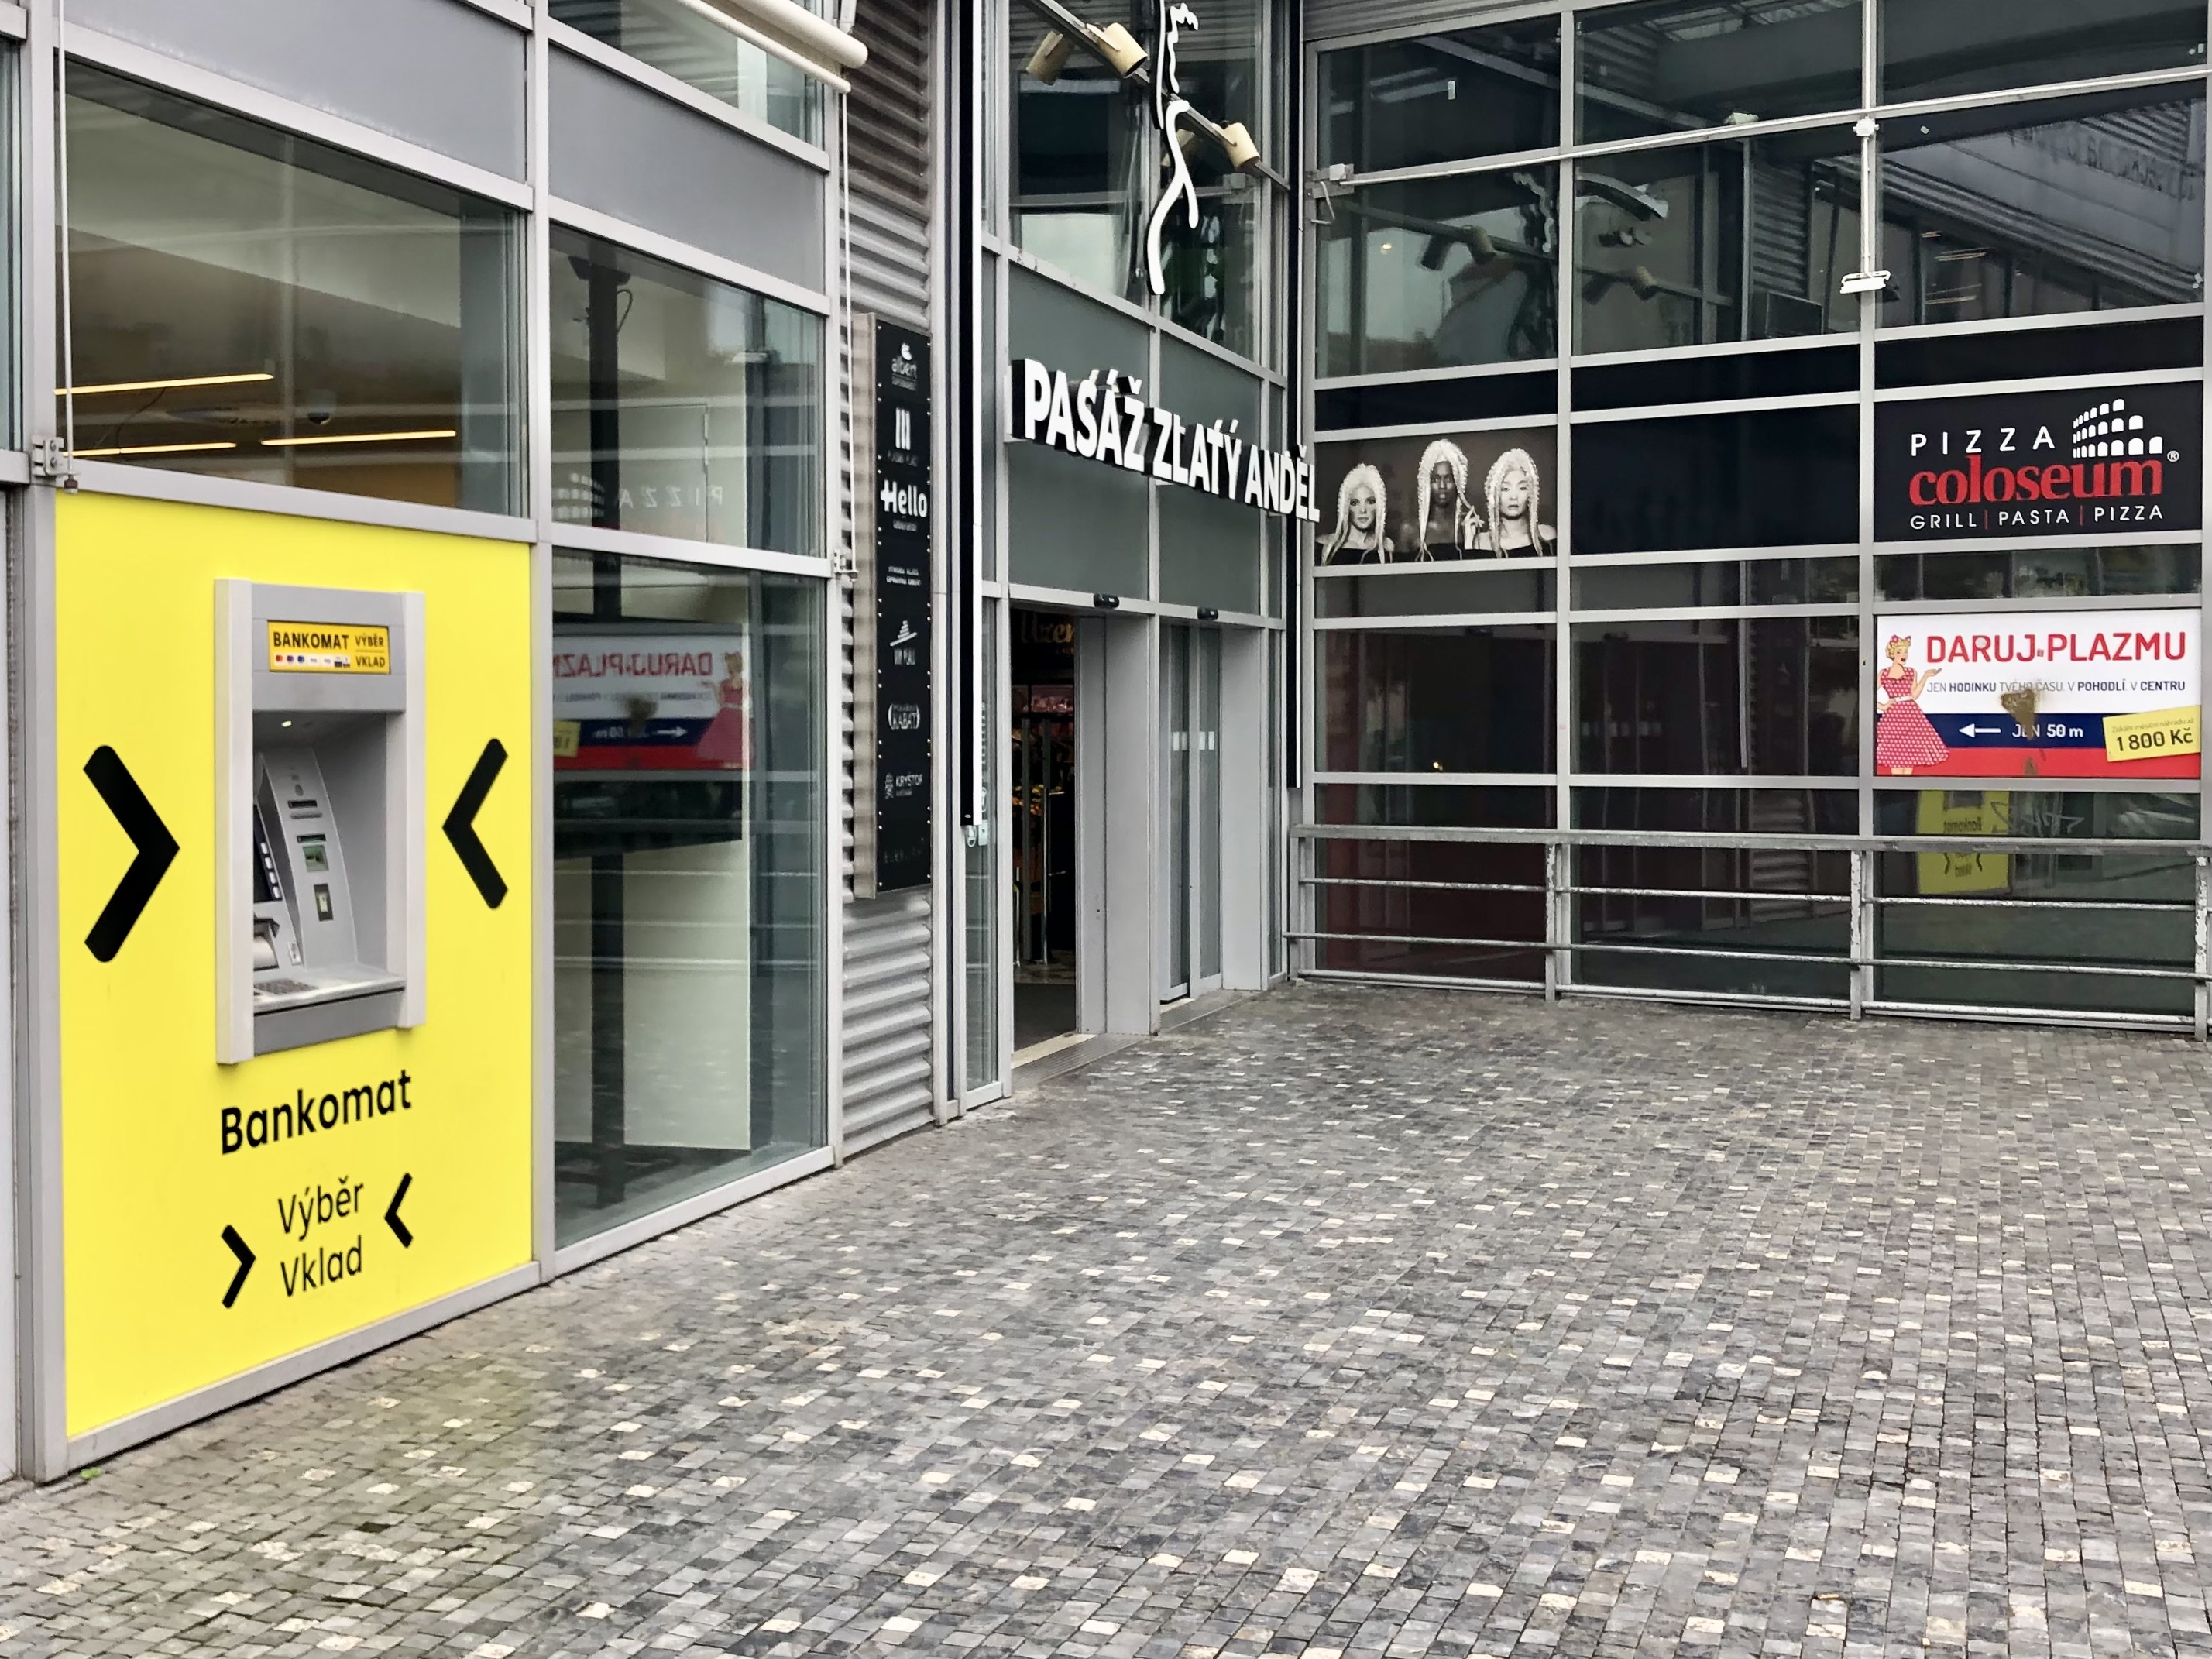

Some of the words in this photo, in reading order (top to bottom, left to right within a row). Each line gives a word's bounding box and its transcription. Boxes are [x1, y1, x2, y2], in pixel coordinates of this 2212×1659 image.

[1024, 357, 1145, 472] PASÁŽ
[1152, 406, 1242, 500] ZLATÝ
[1245, 444, 1320, 523] ANDĚL
[1911, 425, 2055, 457] PIZZA
[1909, 454, 2163, 507] coloseum
[880, 479, 927, 517] Hello
[1910, 512, 1977, 531] GRILL
[1999, 509, 2069, 527] PASTA
[2094, 504, 2163, 523] PIZZA
[273, 631, 349, 650] BANKOMAT
[355, 632, 384, 647] VÝBĚR
[1927, 634, 2035, 663] DARUJ
[2048, 632, 2186, 661] PLAZMU
[356, 655, 385, 668] VKLAD
[1927, 682, 1946, 692] JEN
[1949, 682, 1997, 692] HODINKU
[2068, 682, 2076, 692] V
[2131, 681, 2138, 691] V
[2140, 681, 2186, 691] CENTRU
[2046, 723, 2066, 737] 50
[2069, 728, 2083, 737] m
[2170, 726, 2193, 745] Kč
[221, 1069, 412, 1155] Bankomat
[277, 1176, 364, 1242] Výběr
[280, 1235, 363, 1298] Vklad
